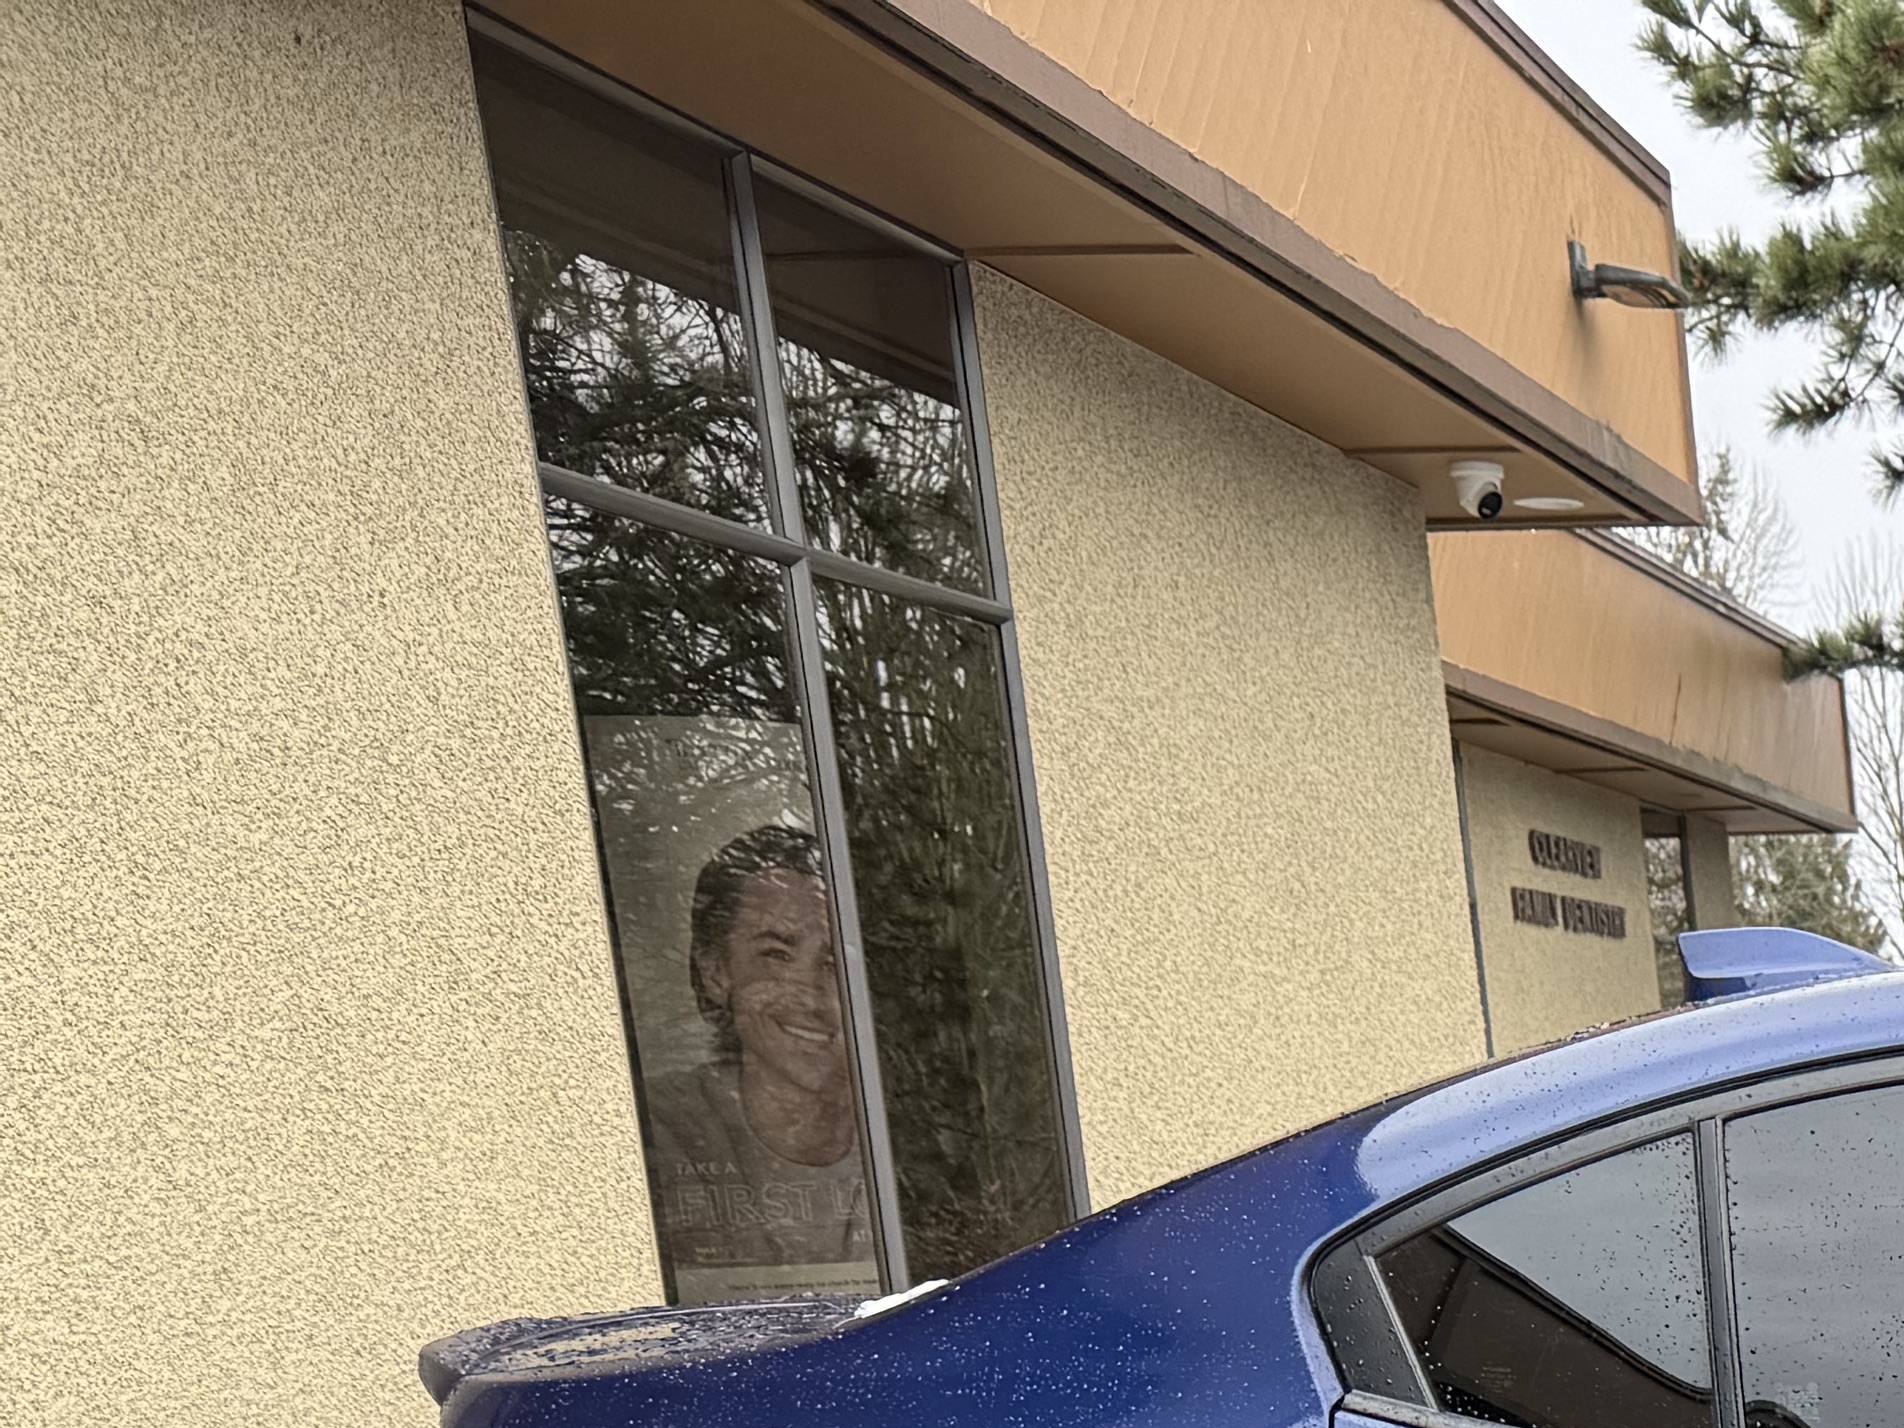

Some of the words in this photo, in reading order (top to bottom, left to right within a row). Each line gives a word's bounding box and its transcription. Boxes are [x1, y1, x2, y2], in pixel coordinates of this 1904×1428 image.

[676, 1161, 720, 1175] TAKE
[725, 1161, 739, 1174] A
[676, 1181, 817, 1227] FIRST
